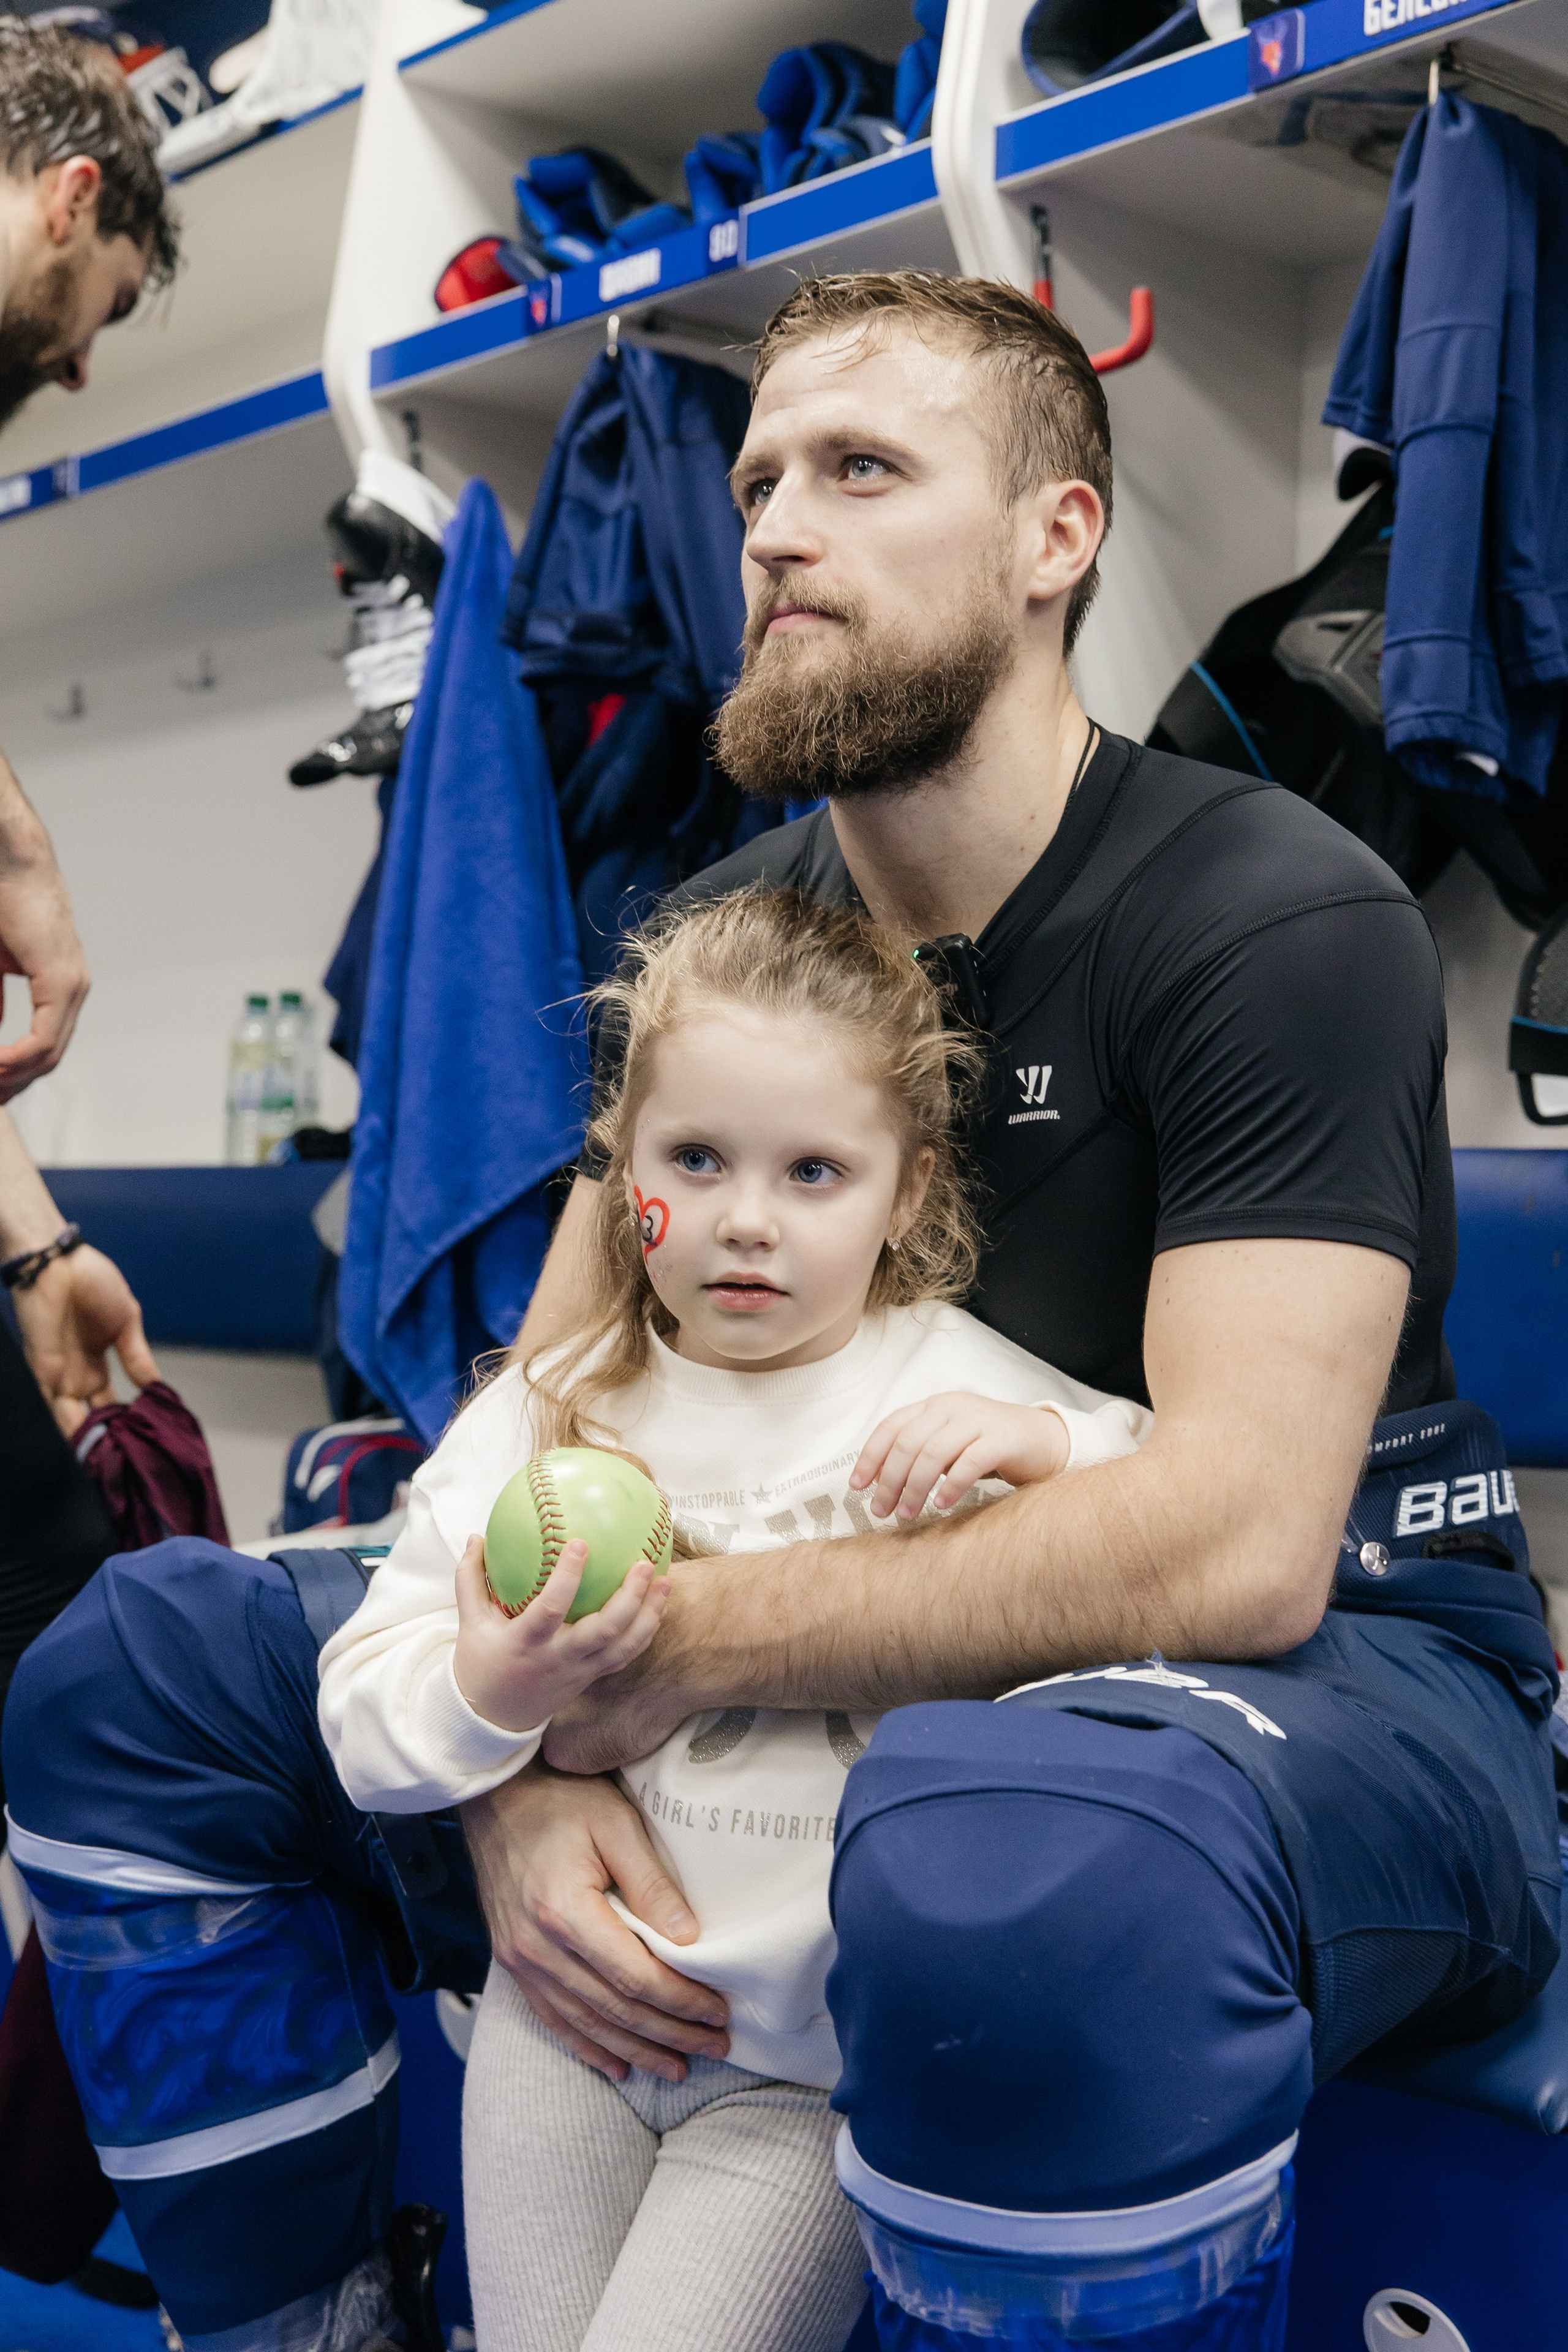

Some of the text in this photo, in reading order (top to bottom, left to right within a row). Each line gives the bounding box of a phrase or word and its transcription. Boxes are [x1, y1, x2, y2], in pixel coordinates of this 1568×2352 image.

[1008, 1109, 1060, 1125] WARRIOR
[652, 1790, 720, 1832] GIRL'S
[731, 1809, 836, 1842] FAVORITE
